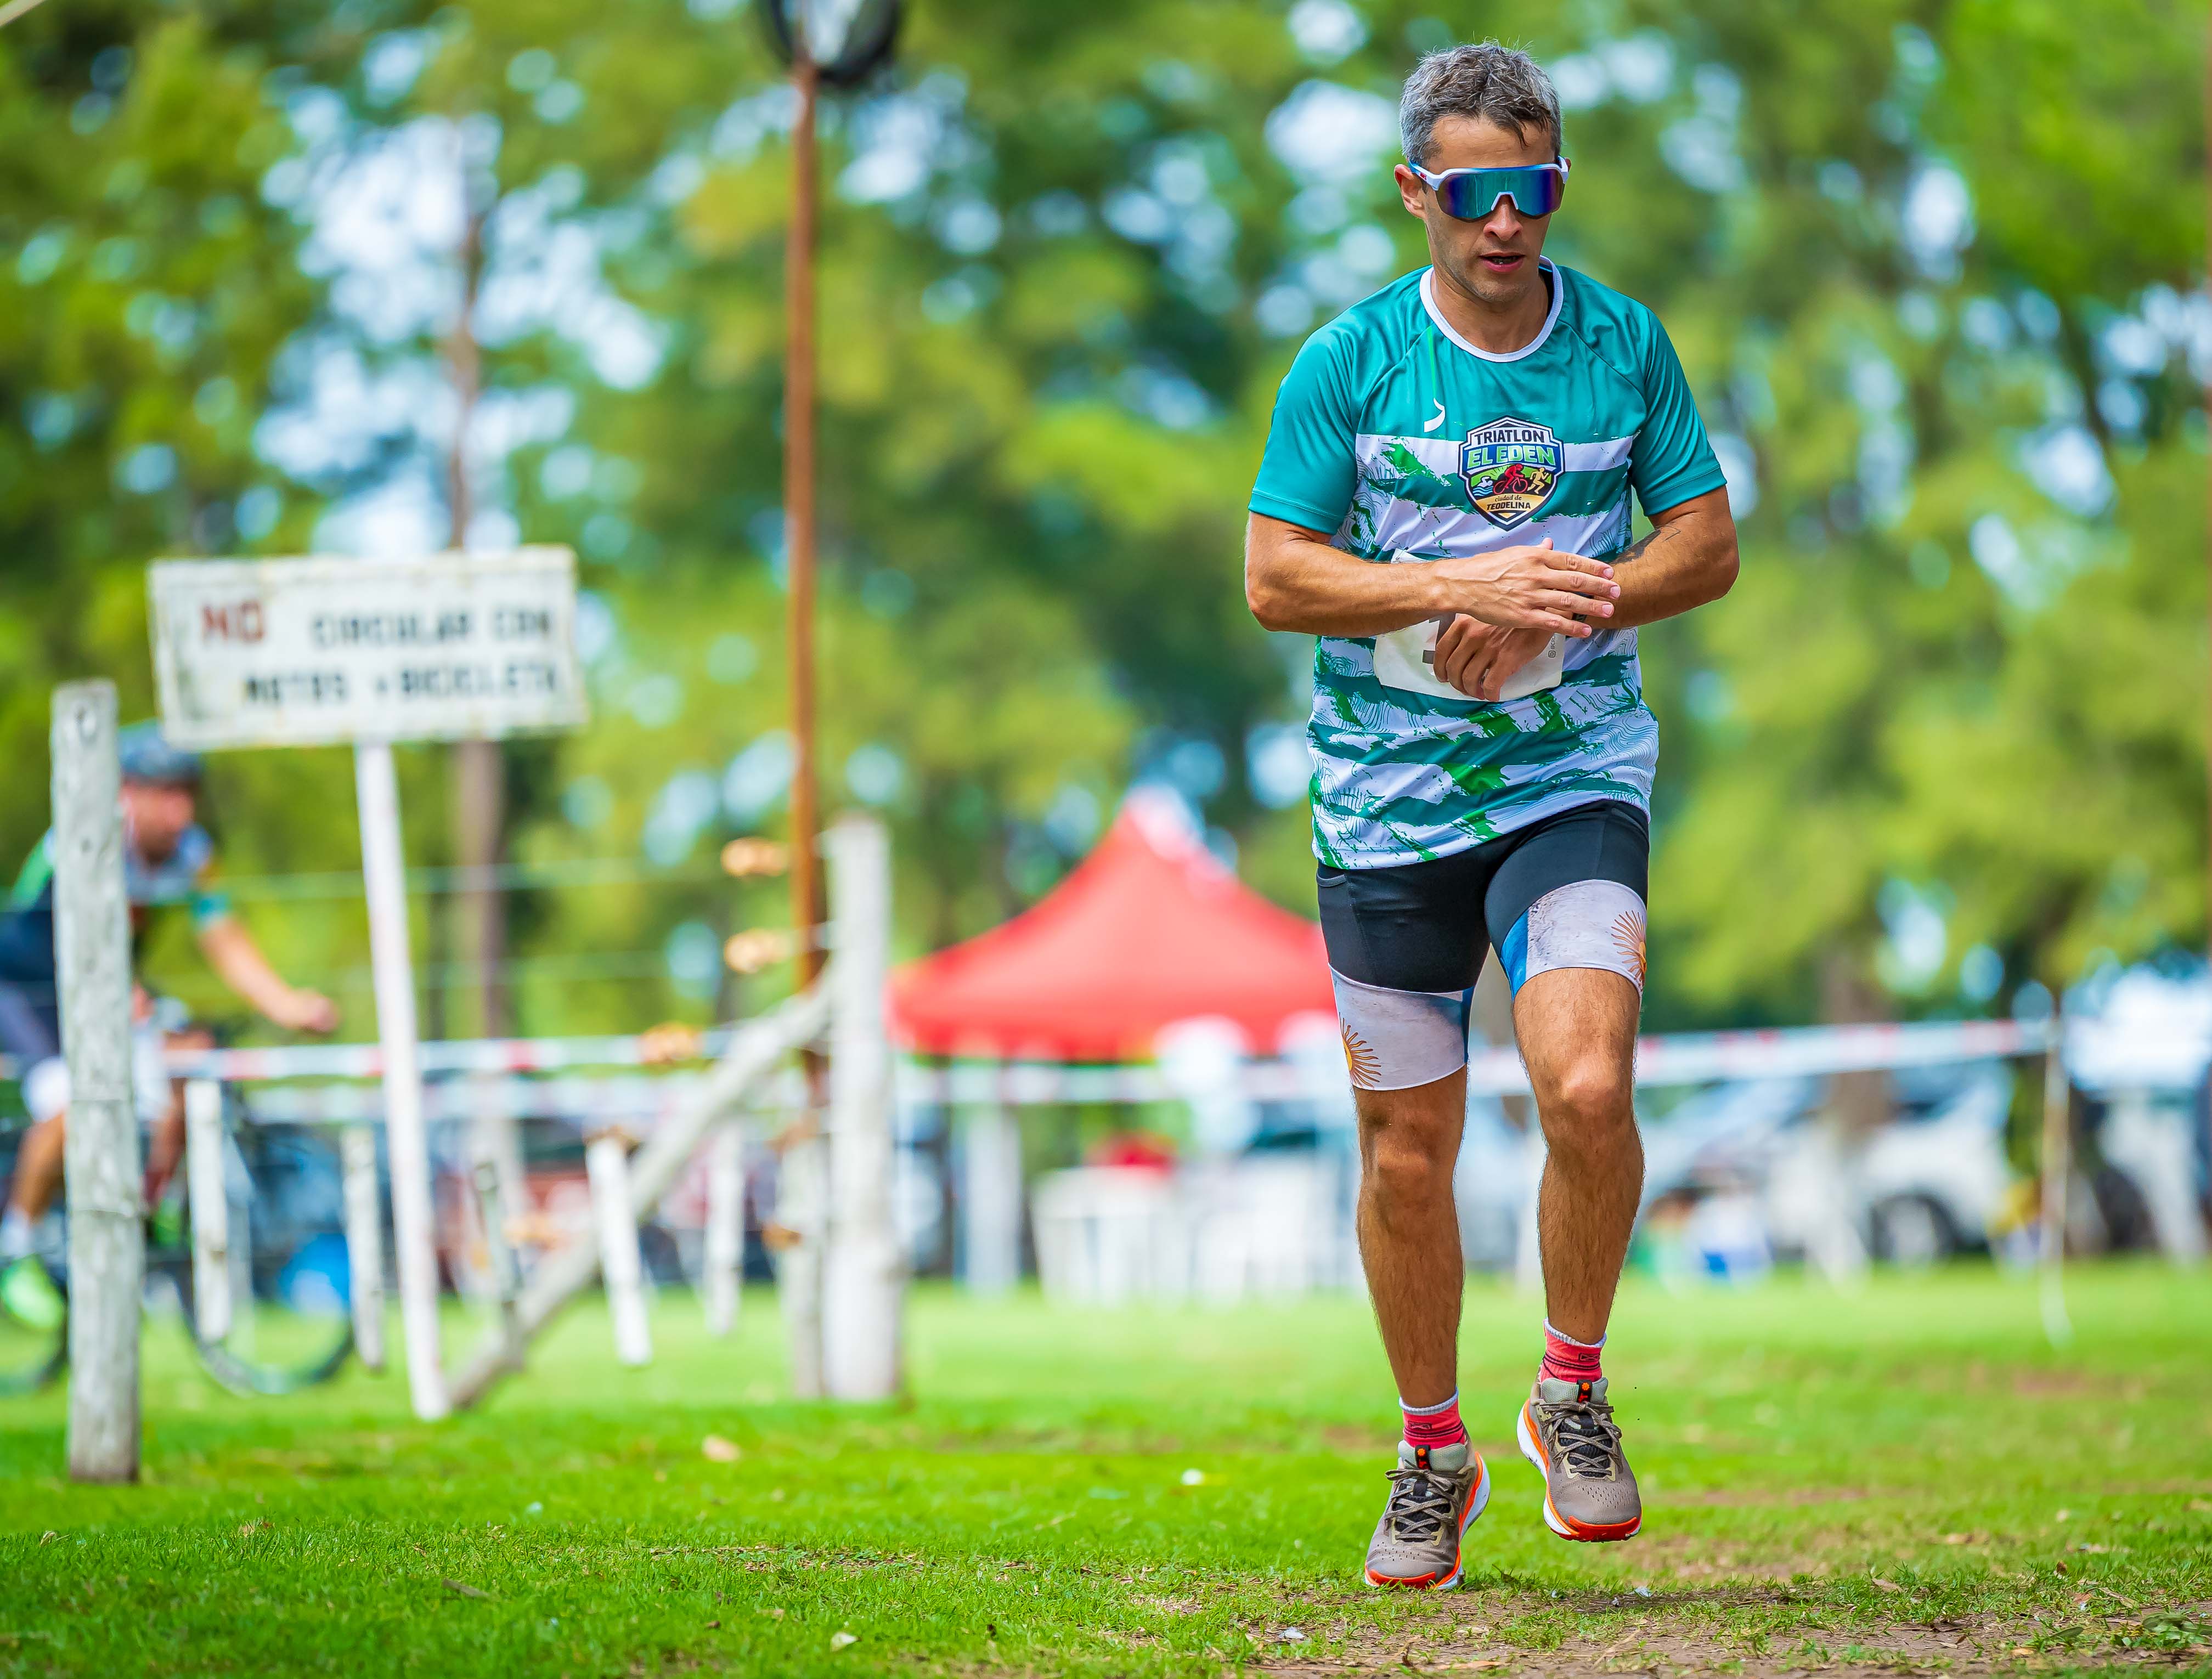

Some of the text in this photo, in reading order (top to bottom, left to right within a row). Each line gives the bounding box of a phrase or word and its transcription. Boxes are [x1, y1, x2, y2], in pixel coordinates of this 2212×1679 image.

[1474, 429, 1544, 445] TRIATLON
[1467, 445, 1556, 468] EL EDEN
[1487, 502, 1531, 510] TEODELINA
[201, 602, 264, 643] NO
